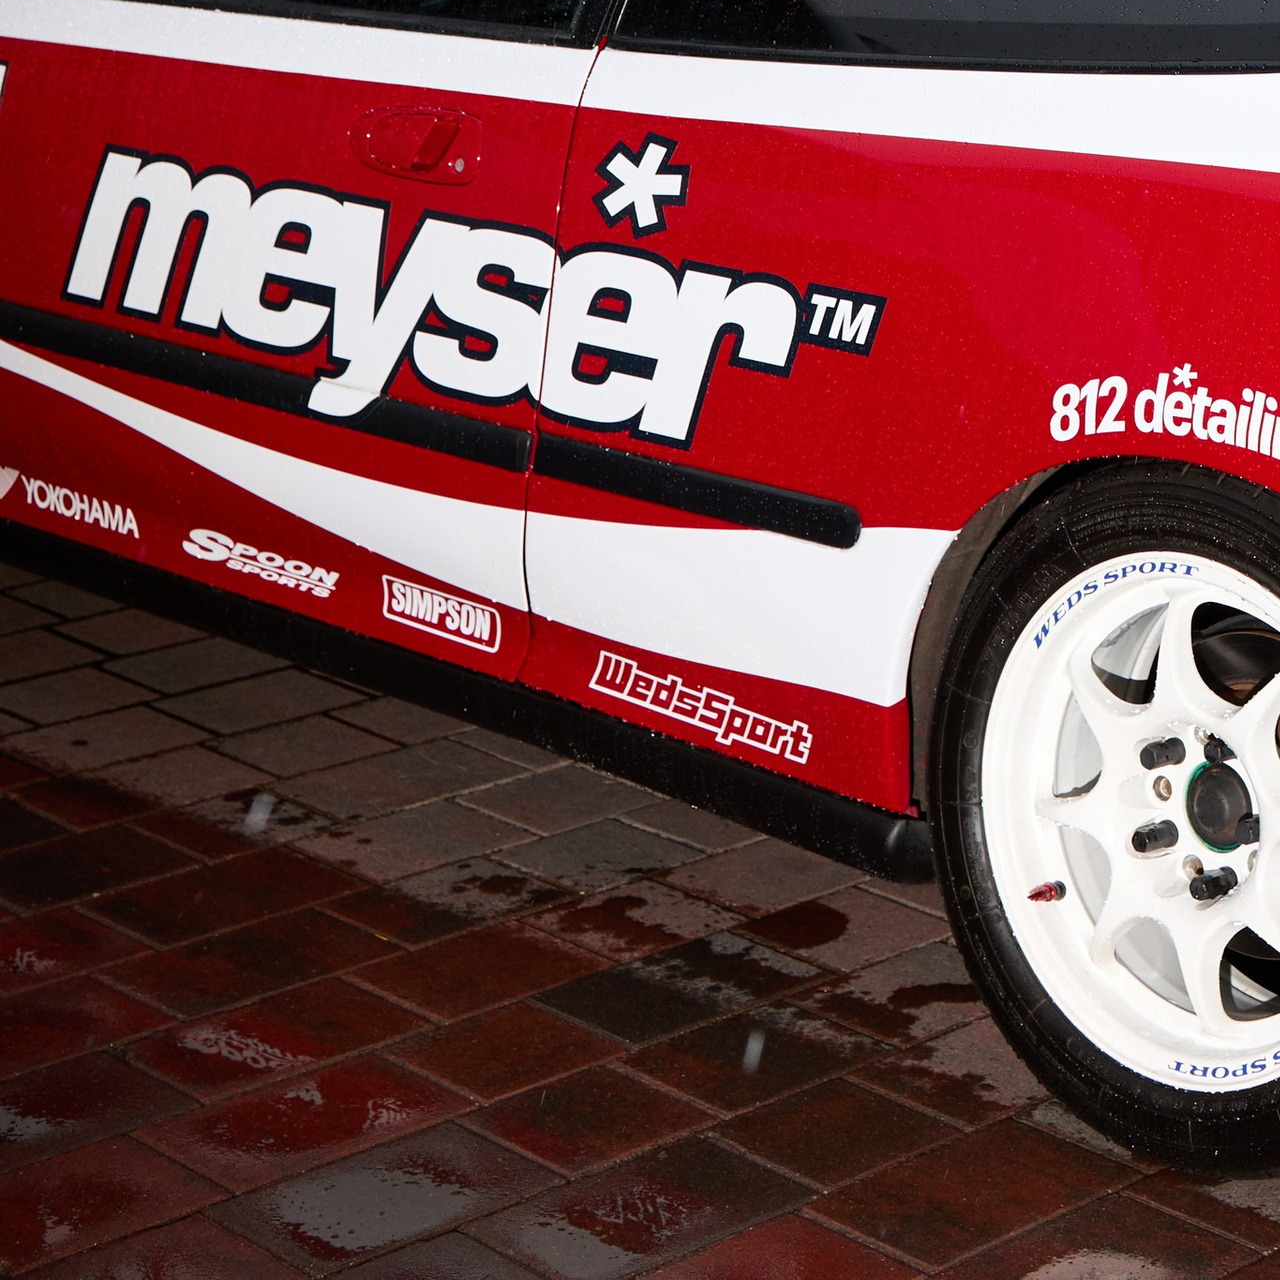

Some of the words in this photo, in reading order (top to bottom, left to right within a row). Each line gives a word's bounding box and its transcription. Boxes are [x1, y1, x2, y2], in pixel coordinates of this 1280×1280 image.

[62, 146, 800, 444] meyser
[1049, 375, 1128, 442] 812
[20, 474, 140, 539] YOKOHAMA
[182, 528, 340, 586] SPOON
[225, 558, 331, 598] SPORTS
[391, 581, 491, 641] SIMPSON
[1032, 579, 1098, 649] WEDS
[1103, 561, 1200, 587] SPORT
[588, 650, 813, 765] WedsSport
[1168, 1057, 1267, 1080] SPORT
